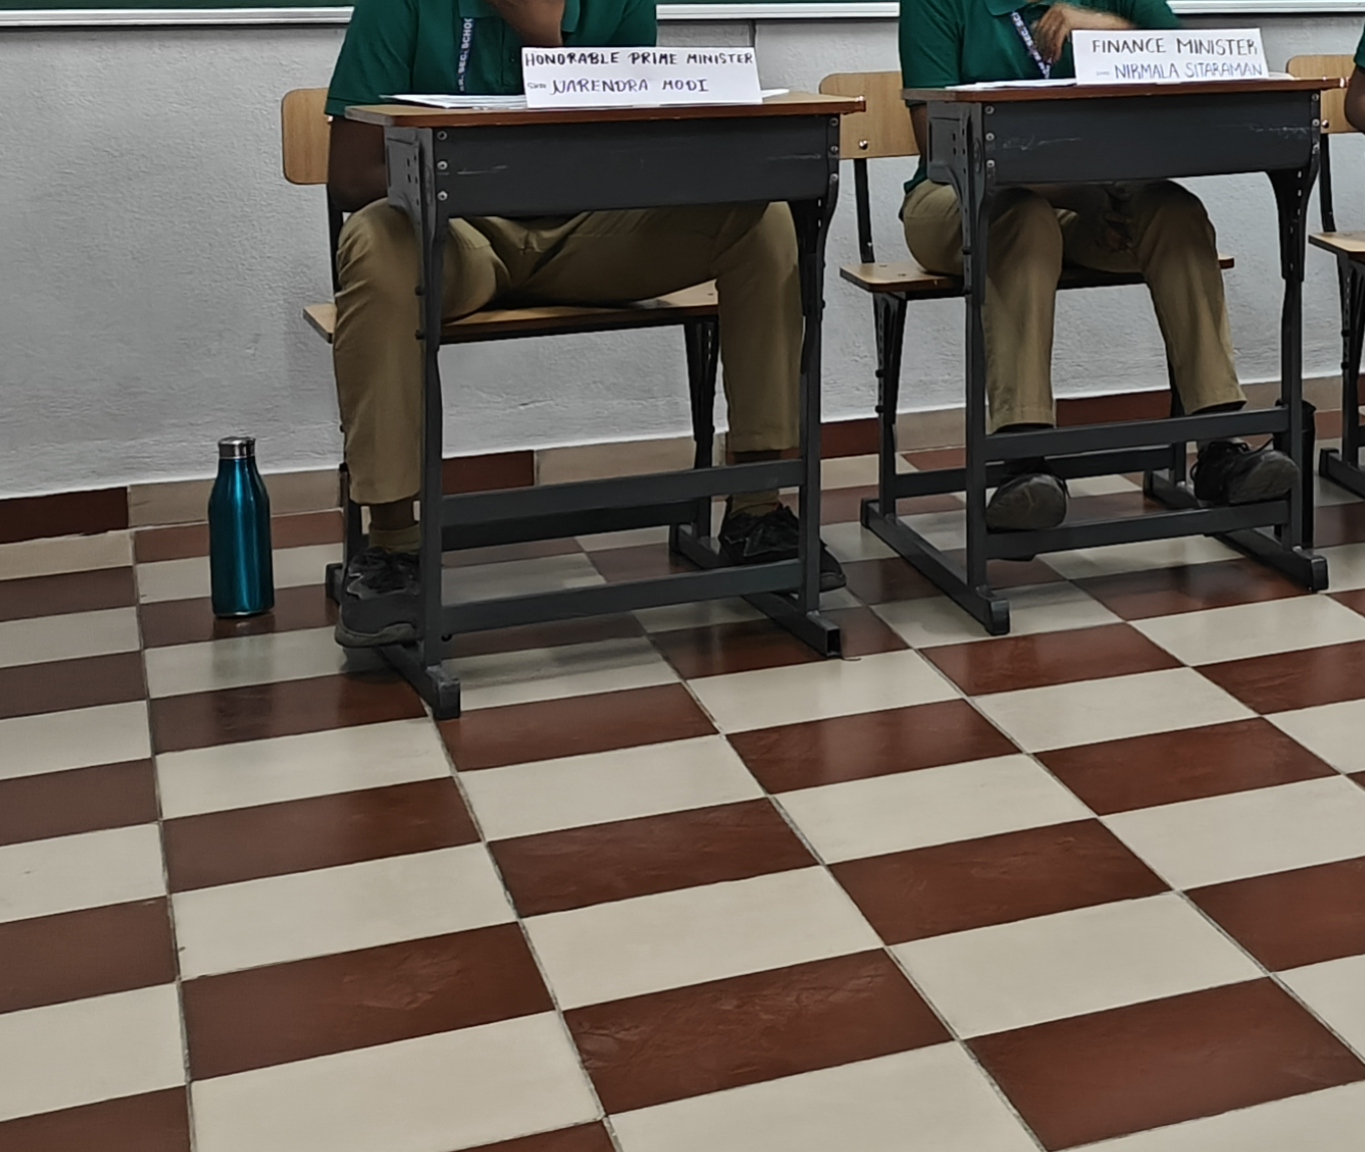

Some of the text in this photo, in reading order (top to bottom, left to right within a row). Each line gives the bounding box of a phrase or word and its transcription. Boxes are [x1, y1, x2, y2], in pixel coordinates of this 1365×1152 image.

[1092, 38, 1258, 55] FINANCE MINISTER
[525, 51, 753, 66] HONORABLE PRIME MINISTER
[1114, 62, 1263, 79] NIRMALA SITARAMAN
[550, 79, 649, 95] NARENDRA
[662, 79, 709, 92] MODI
